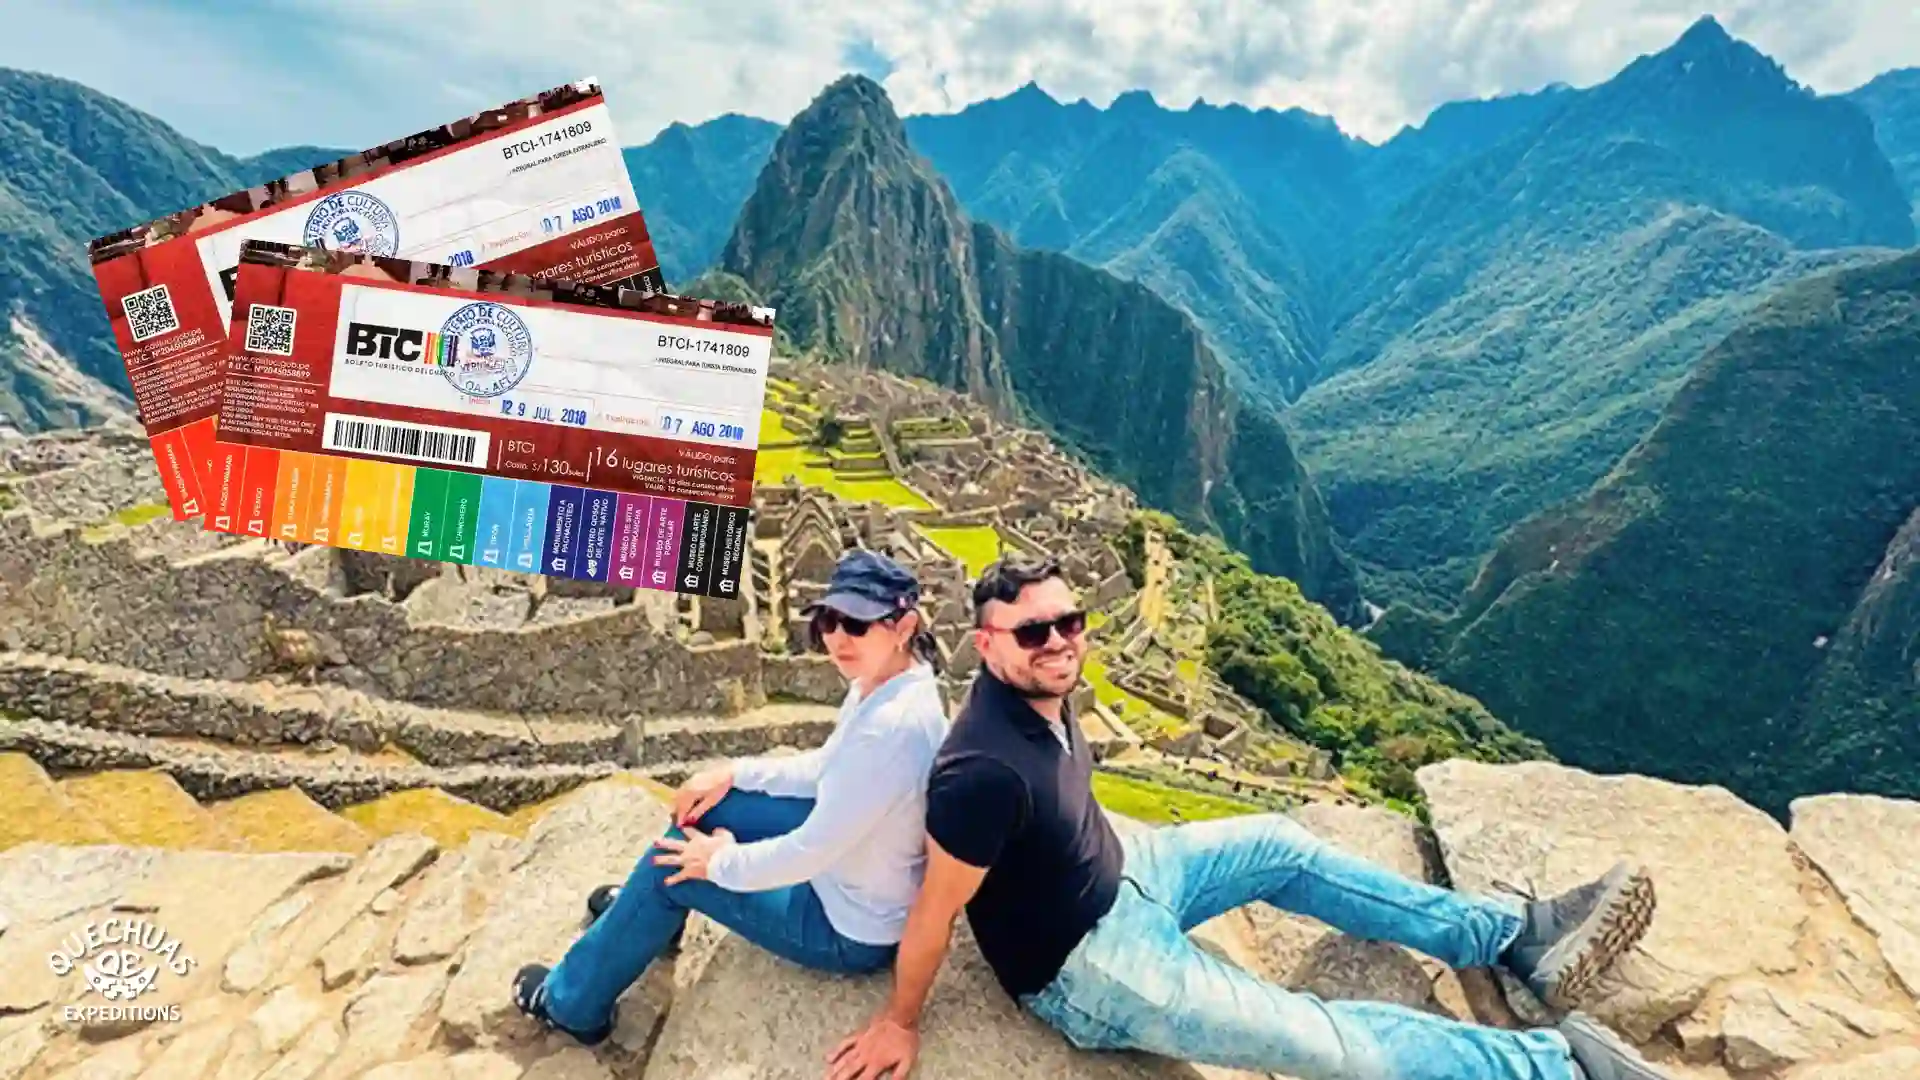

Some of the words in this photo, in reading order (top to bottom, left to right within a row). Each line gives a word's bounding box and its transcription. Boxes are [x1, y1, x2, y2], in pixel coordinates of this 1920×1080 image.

[501, 120, 592, 160] BTCI-1741809
[570, 204, 595, 224] AGO
[657, 334, 749, 357] BTCI-1741809
[533, 406, 555, 421] JUL
[691, 420, 714, 437] AGO
[507, 439, 535, 453] BTCI
[594, 446, 619, 467] 16
[622, 457, 672, 476] lugares
[599, 498, 608, 525] NATIVO
[586, 527, 596, 558] CENTRO
[620, 535, 629, 562] MUSEO
[654, 541, 663, 565] MUSEO
[659, 507, 667, 525] ARTE
[664, 520, 673, 555] POPULAR
[688, 543, 697, 568] MUSEO
[693, 512, 701, 531] ARTE
[732, 525, 742, 561] REGIONAL
[722, 550, 730, 575] MUSEO
